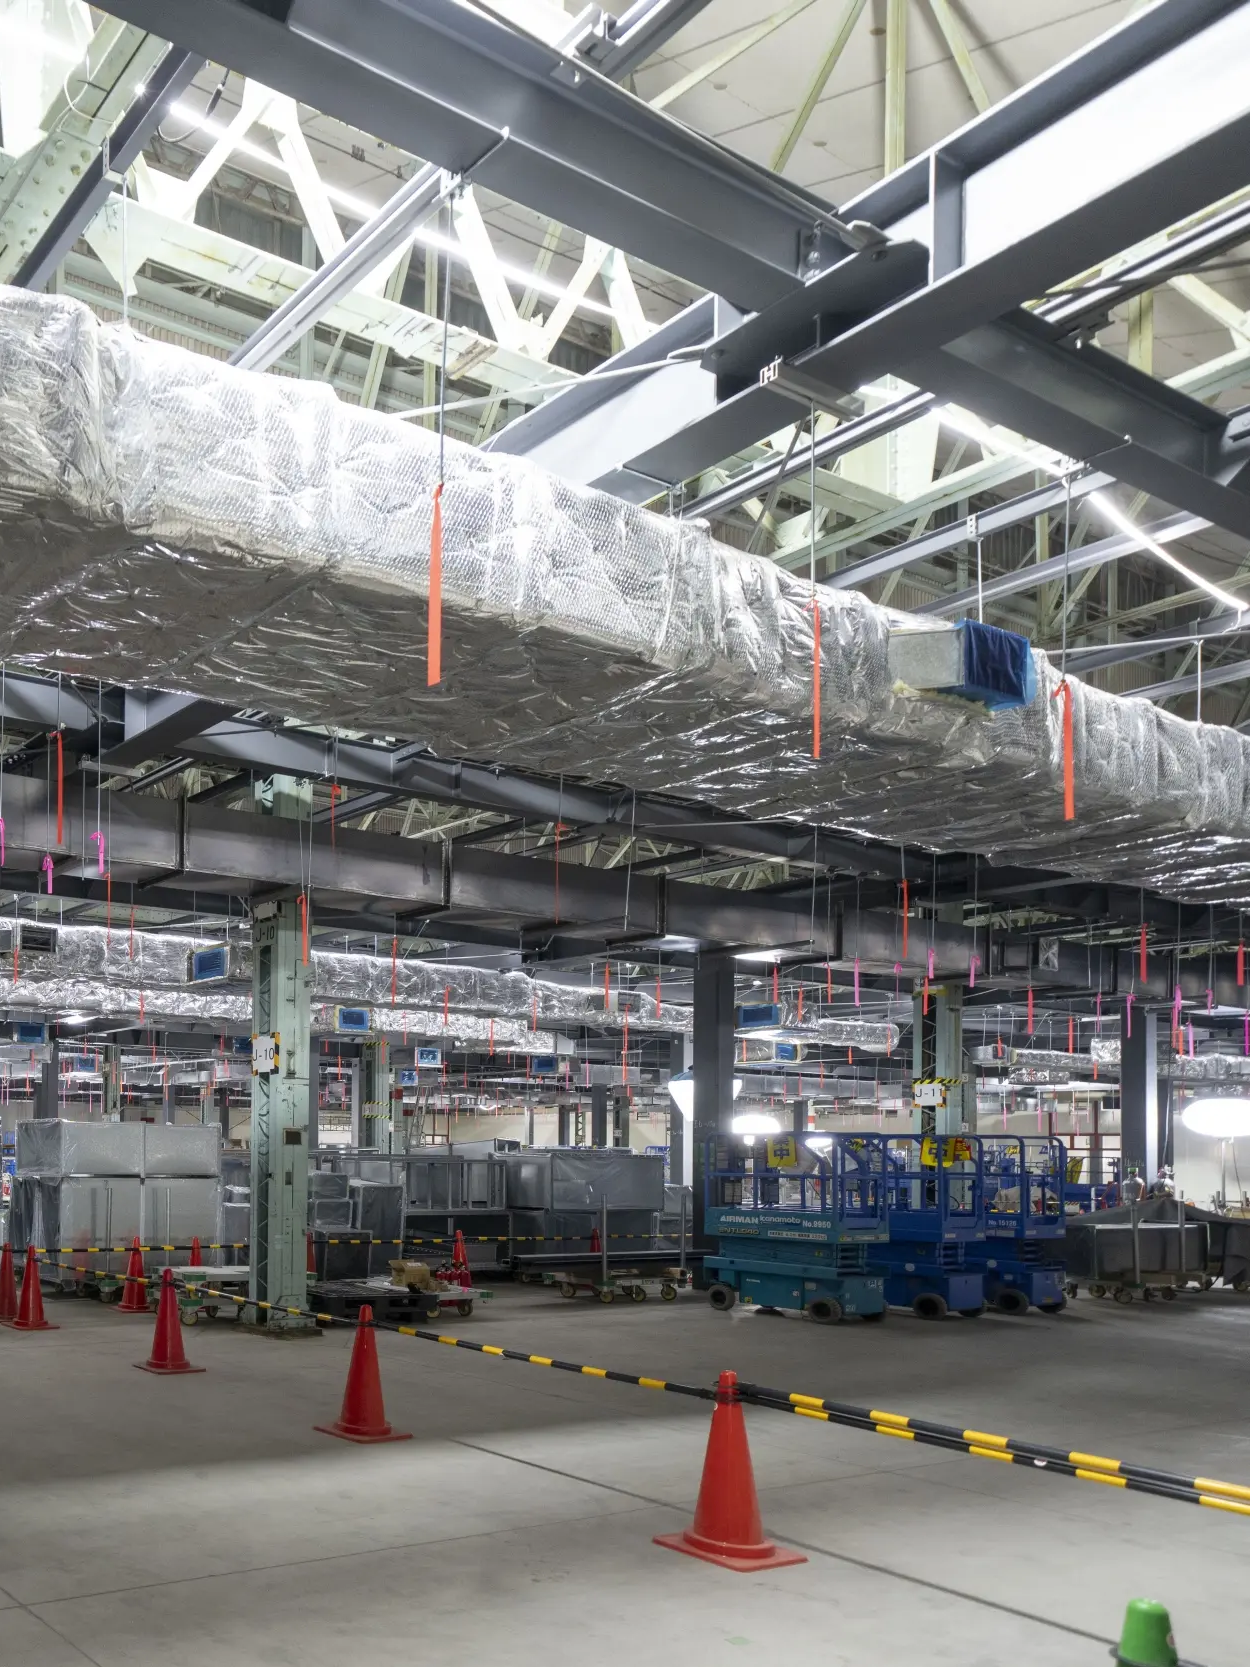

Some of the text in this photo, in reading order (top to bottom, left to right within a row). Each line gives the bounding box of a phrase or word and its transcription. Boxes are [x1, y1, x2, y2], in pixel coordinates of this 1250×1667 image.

[255, 926, 275, 943] J-10
[252, 1047, 275, 1062] J-10
[915, 1087, 943, 1098] J-11
[720, 1214, 759, 1225] AIRMAN
[759, 1214, 801, 1224] kanamoto
